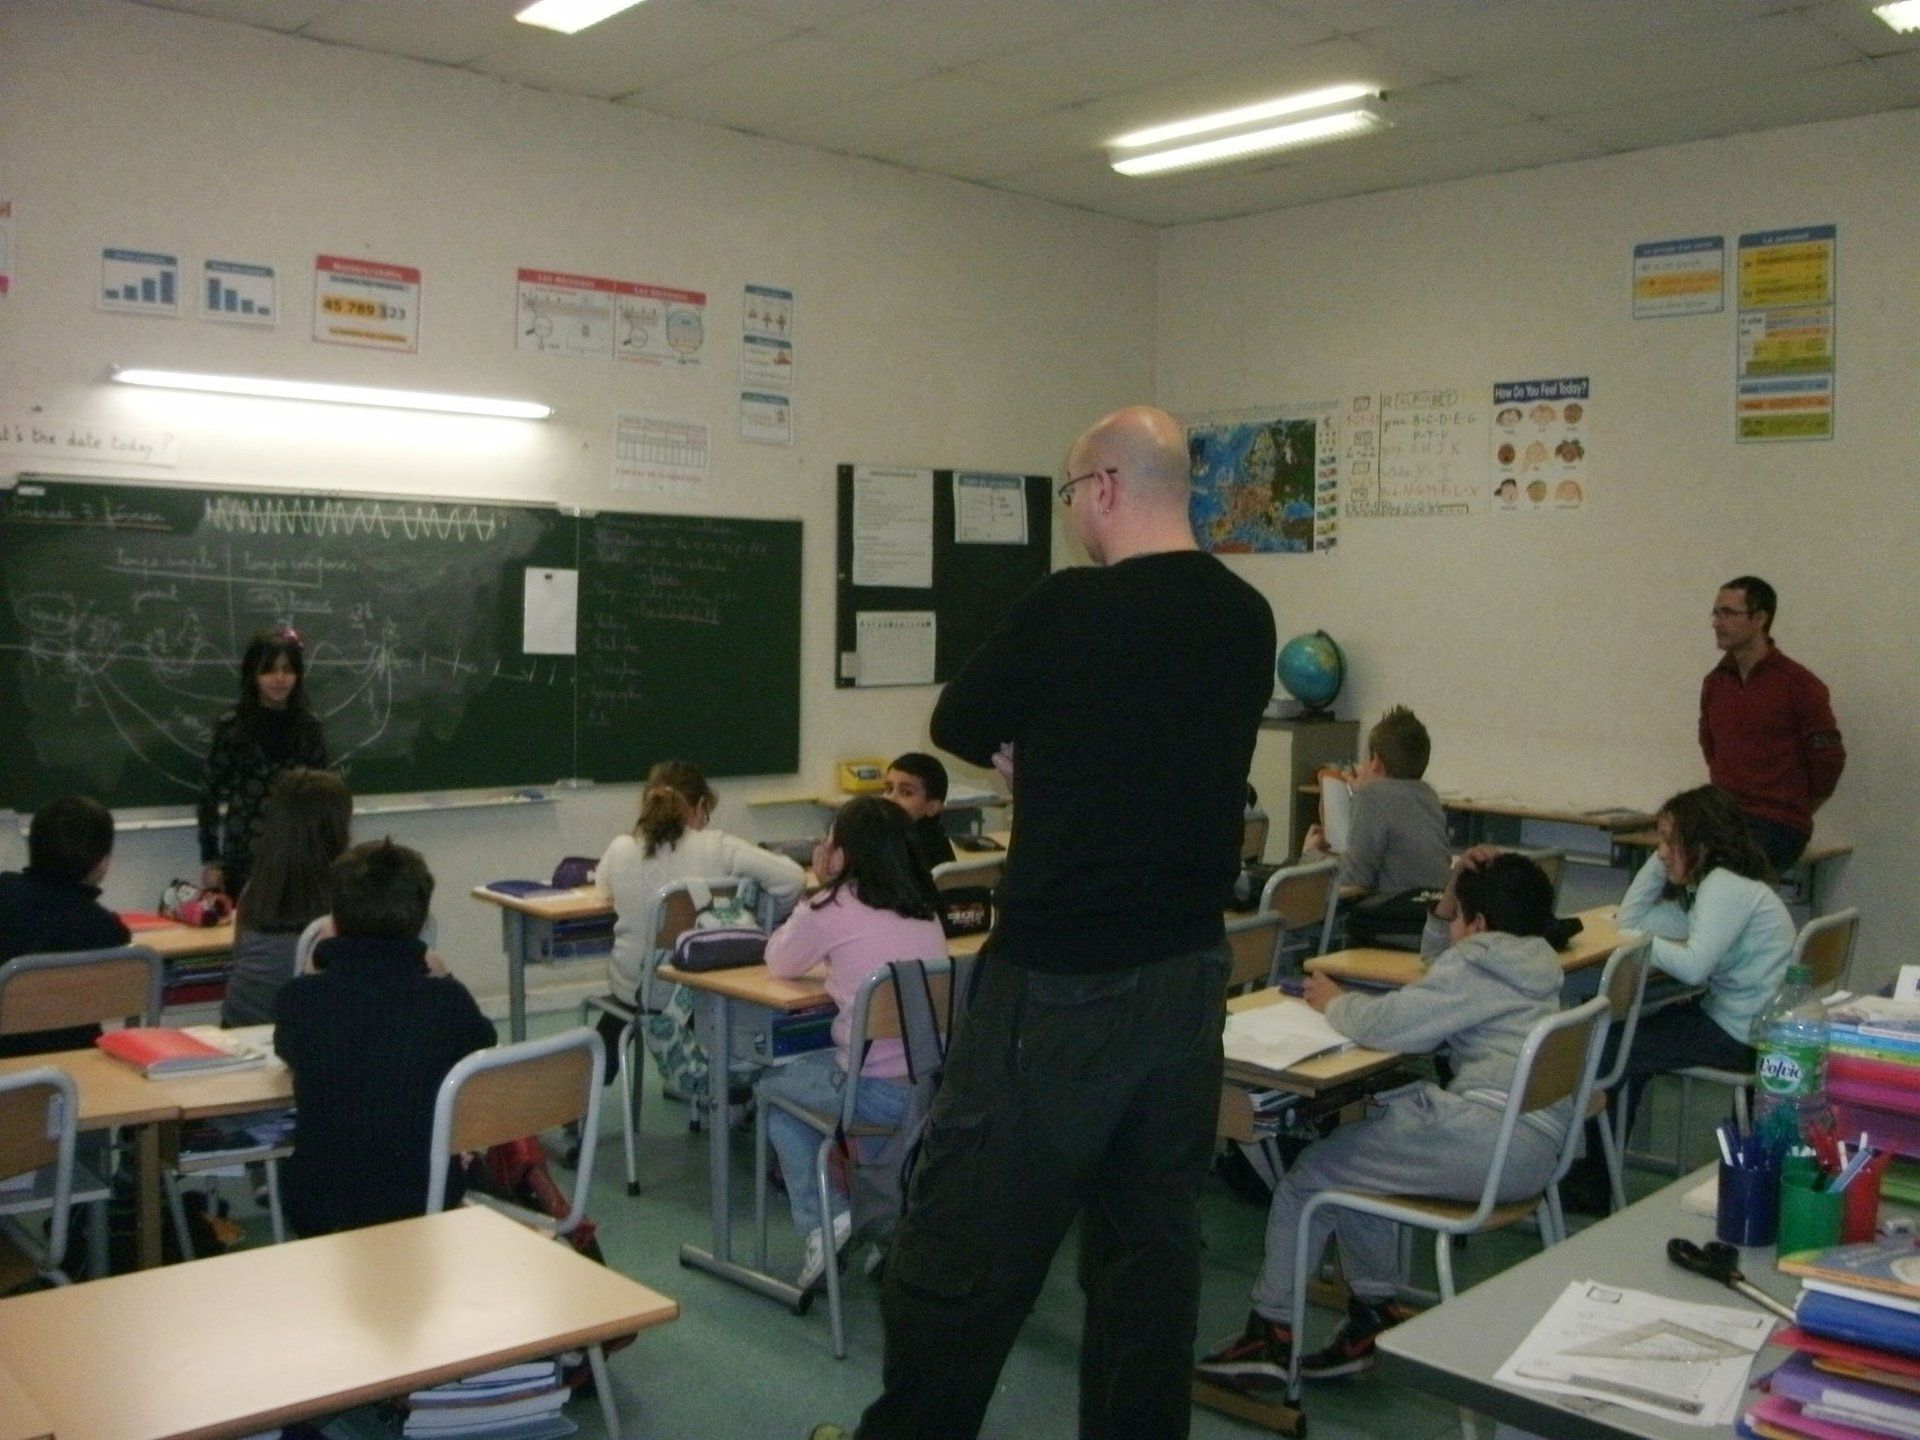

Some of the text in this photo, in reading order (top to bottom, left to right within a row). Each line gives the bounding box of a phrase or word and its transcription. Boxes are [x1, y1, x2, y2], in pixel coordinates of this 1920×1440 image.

[1495, 381, 1587, 399] How Do You Feel Today?
[32, 426, 56, 445] the
[67, 430, 102, 449] date
[110, 436, 153, 460] today
[1760, 1057, 1800, 1078] Volvic
